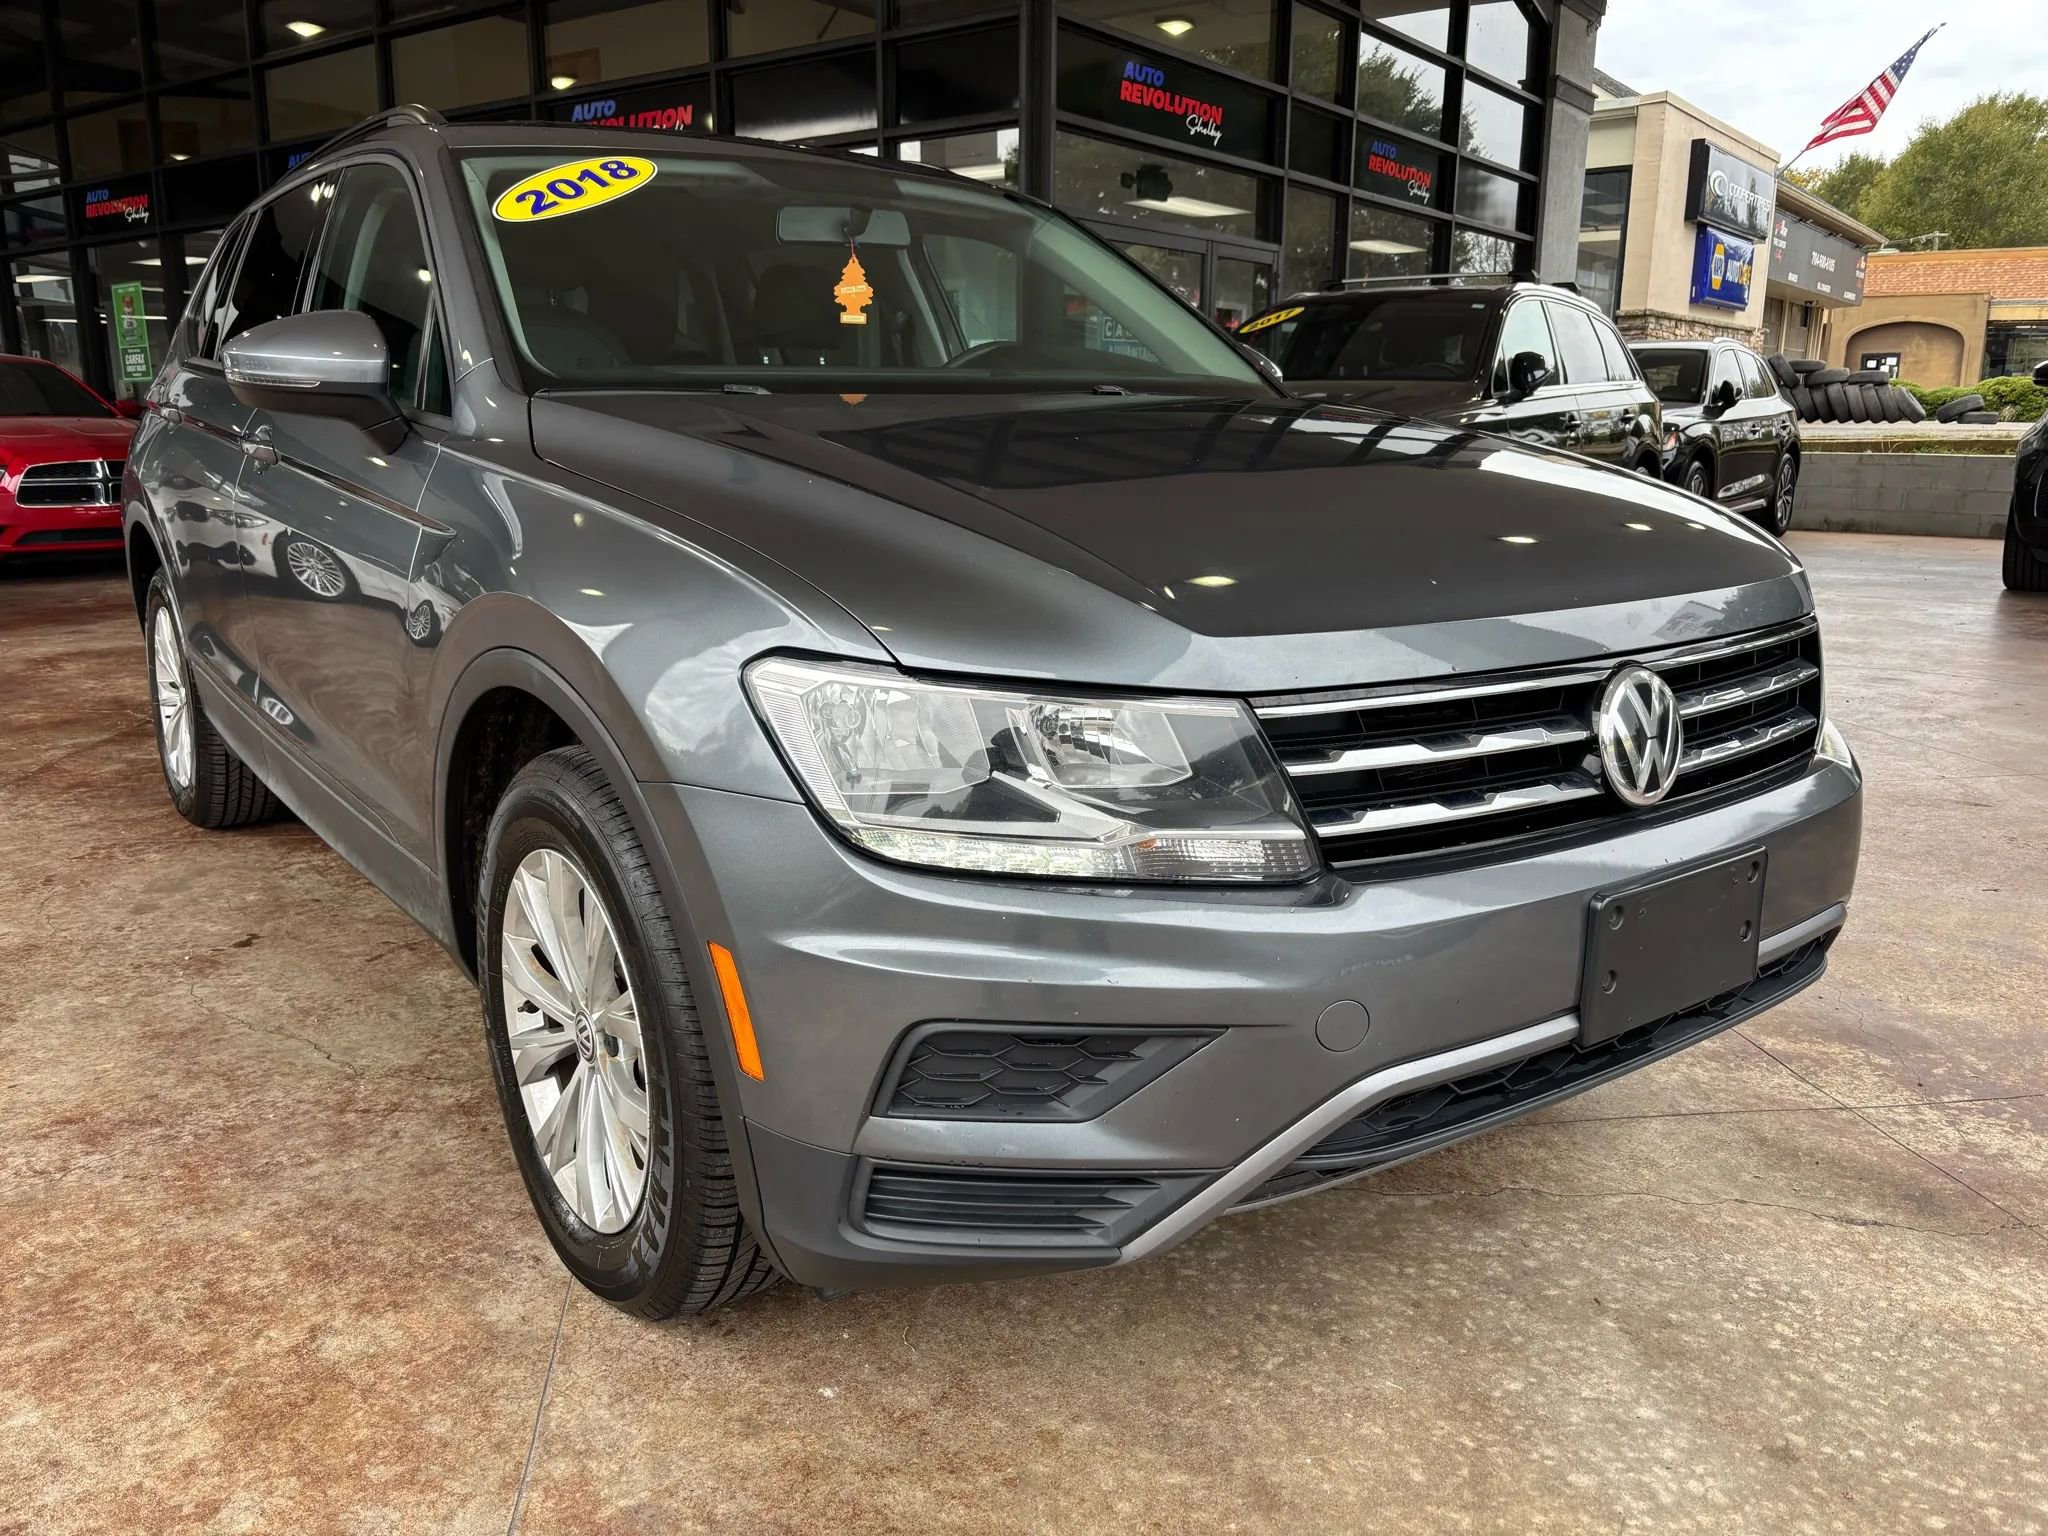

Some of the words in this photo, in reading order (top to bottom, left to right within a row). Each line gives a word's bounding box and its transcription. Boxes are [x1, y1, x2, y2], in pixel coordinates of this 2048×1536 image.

[1124, 61, 1164, 87] AUTO
[571, 100, 616, 122] AUTO
[1120, 80, 1223, 125] REVOLUTION
[1186, 114, 1222, 146] Shelby
[1371, 141, 1396, 159] AUTO
[1369, 154, 1432, 188] REVOLUTION
[86, 189, 109, 203] AUTO
[515, 160, 640, 216] 2018
[1408, 180, 1430, 204] Shelby
[86, 194, 148, 218] REVOLUTION
[125, 203, 149, 224] Shelby
